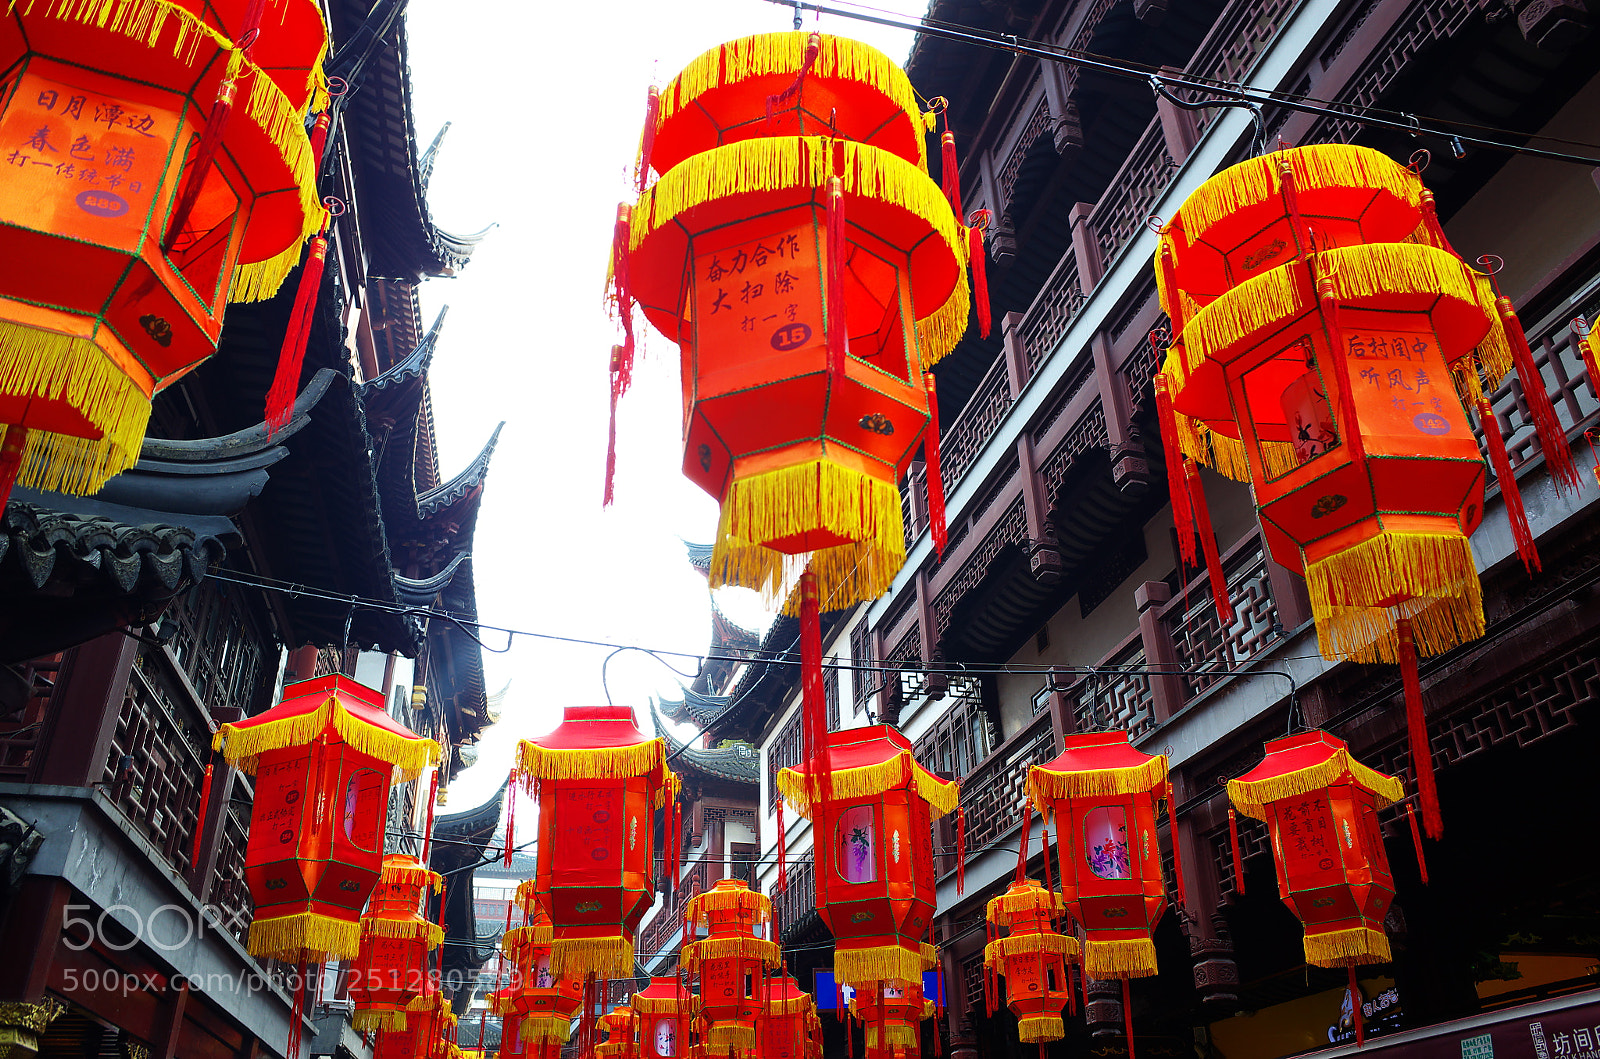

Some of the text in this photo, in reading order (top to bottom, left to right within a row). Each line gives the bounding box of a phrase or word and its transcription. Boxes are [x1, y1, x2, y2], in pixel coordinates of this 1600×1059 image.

[37, 89, 156, 138] 日月潭边
[21, 124, 136, 172] 春色满
[6, 150, 143, 194] 打一传统节日
[705, 234, 800, 283] 奋力合作
[710, 270, 799, 315] 大扫除
[740, 303, 799, 333] 打一字
[778, 326, 806, 348] 15
[1359, 366, 1430, 394] 听风声
[1418, 418, 1446, 430] 142
